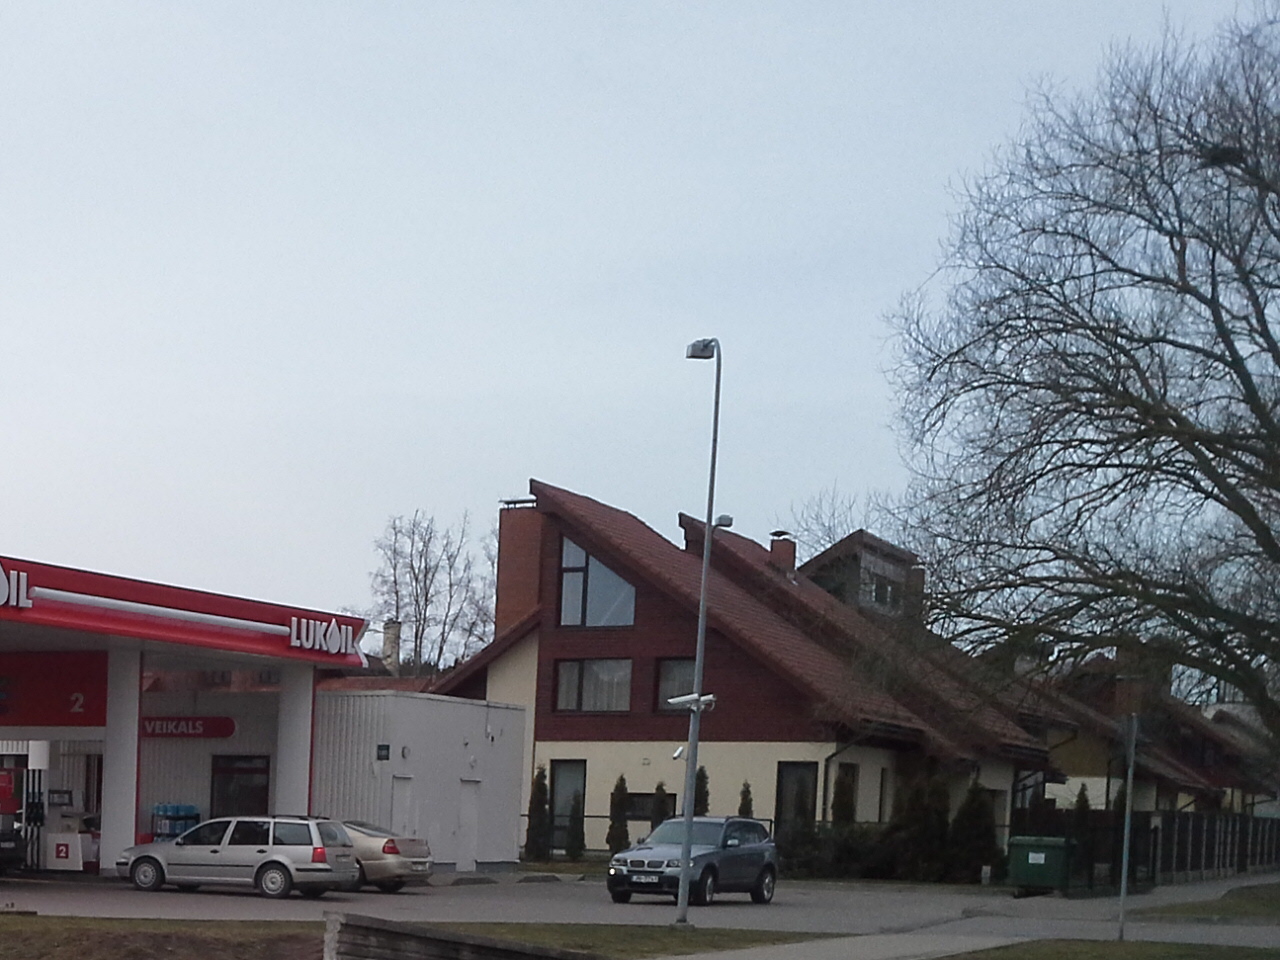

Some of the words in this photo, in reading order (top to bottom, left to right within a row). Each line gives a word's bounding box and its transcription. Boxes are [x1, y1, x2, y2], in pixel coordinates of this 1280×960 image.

[290, 616, 357, 654] LUKOIL
[70, 692, 84, 713] 2
[144, 721, 204, 734] VEIKALS
[58, 846, 67, 857] 2
